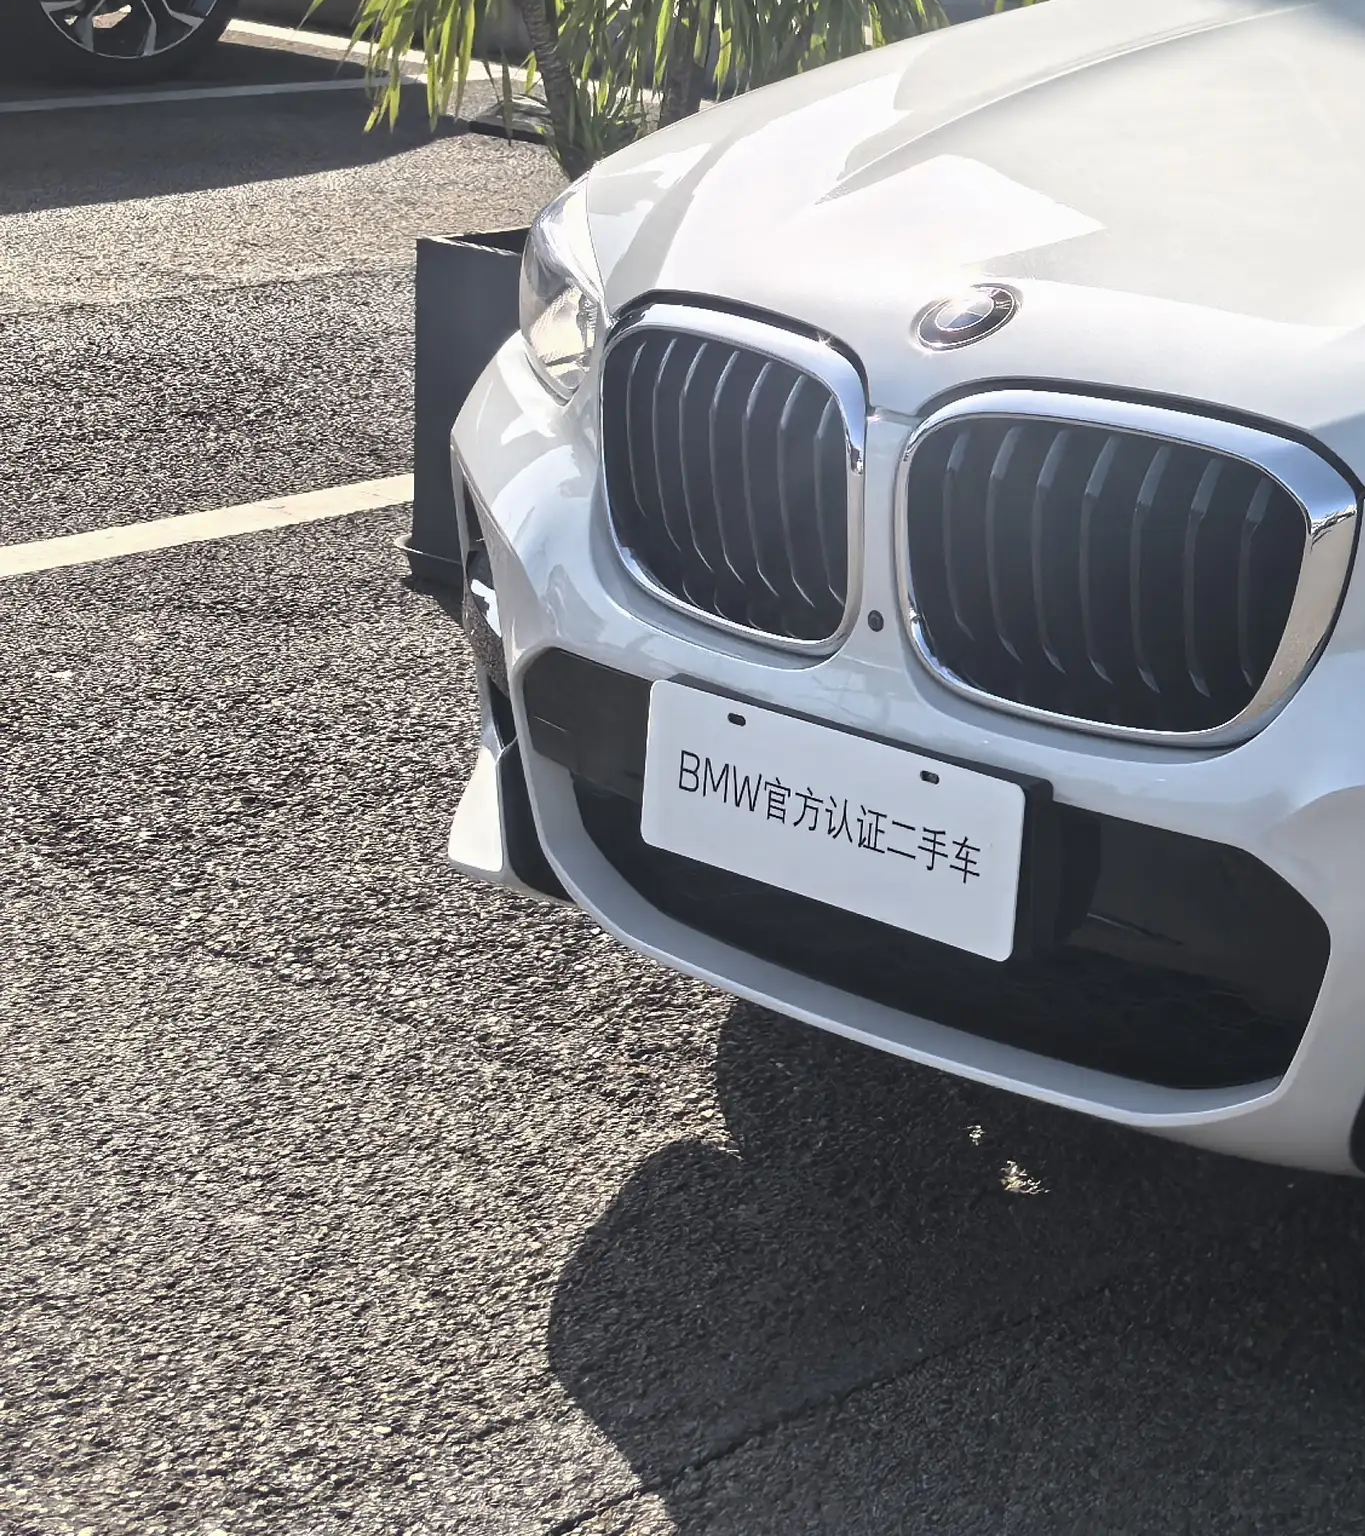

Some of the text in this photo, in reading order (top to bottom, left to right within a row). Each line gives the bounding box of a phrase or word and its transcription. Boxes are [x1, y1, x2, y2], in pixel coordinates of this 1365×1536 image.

[678, 750, 982, 885] BMW官方认证二手车
